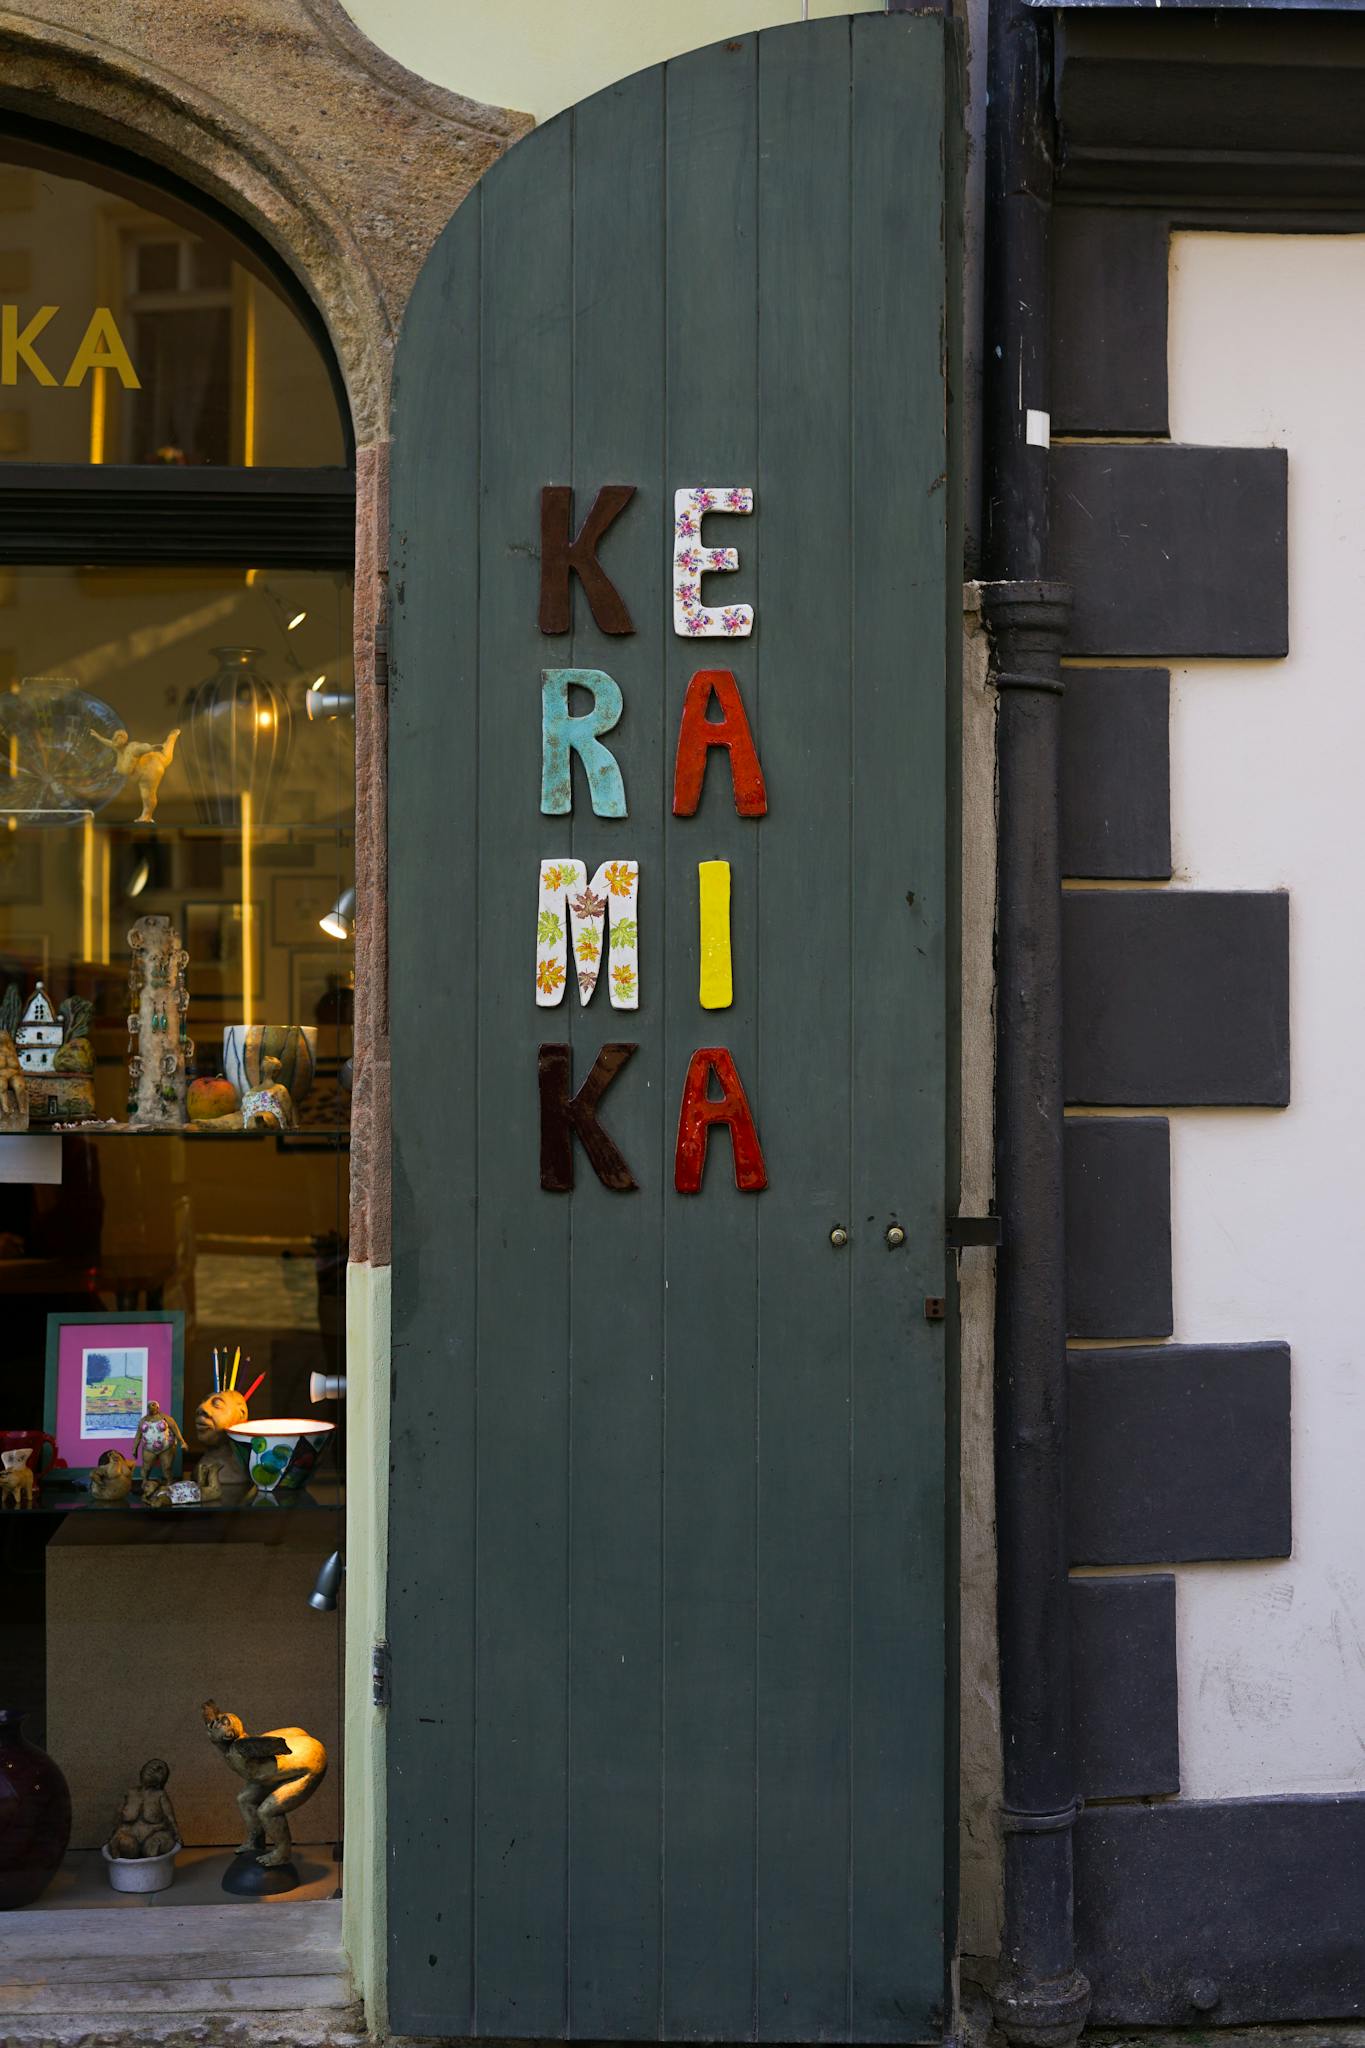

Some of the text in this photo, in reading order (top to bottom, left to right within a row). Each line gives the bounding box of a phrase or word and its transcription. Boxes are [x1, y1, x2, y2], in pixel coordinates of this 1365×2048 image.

[2, 304, 142, 389] KA
[539, 485, 755, 638] KE
[540, 668, 768, 818] RA
[536, 858, 734, 1010] MI
[538, 1042, 769, 1193] KA
